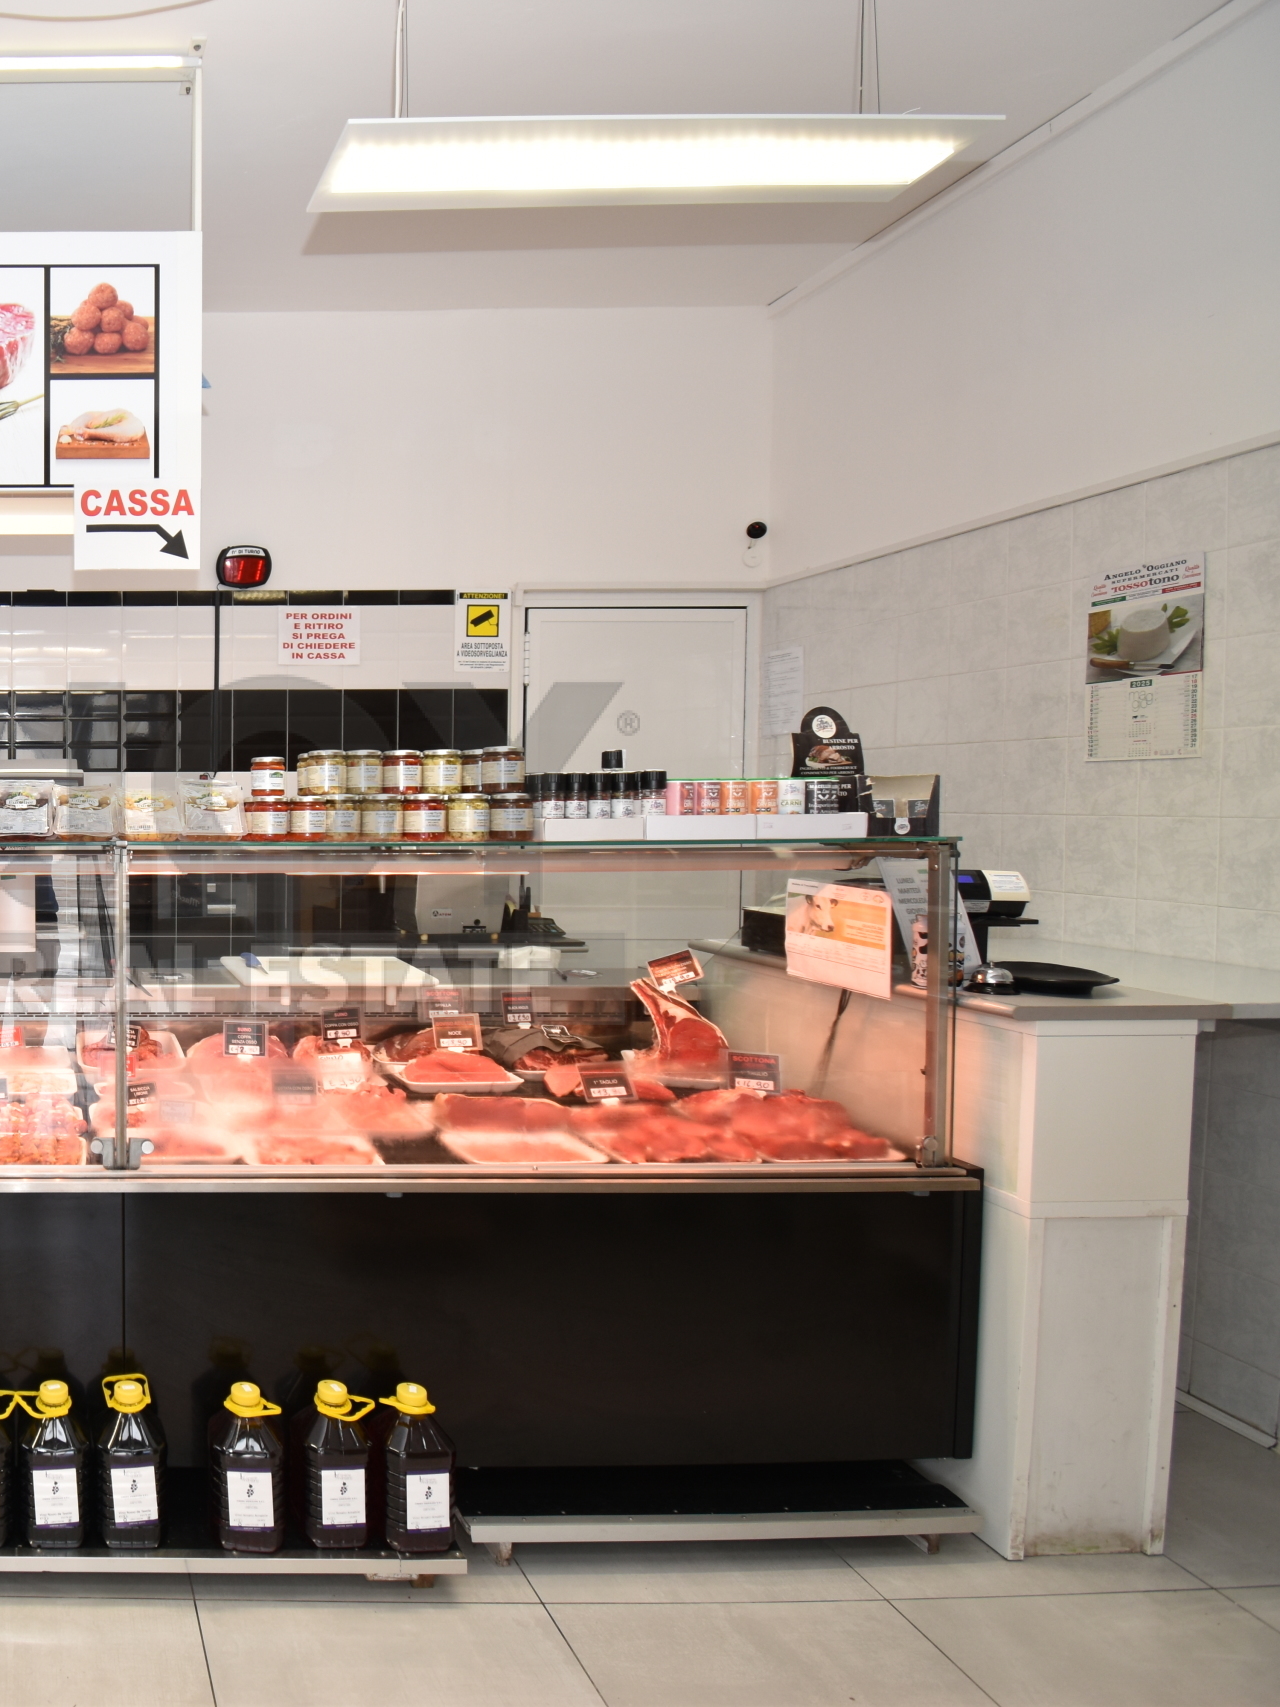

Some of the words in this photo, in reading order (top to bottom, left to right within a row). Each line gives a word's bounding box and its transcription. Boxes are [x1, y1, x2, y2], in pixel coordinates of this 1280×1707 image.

[80, 489, 195, 516] CASSA
[1104, 569, 1141, 580] ANGELO
[1111, 568, 1178, 584] SUPERMERCATI
[732, 1055, 776, 1064] SCOTTONA
